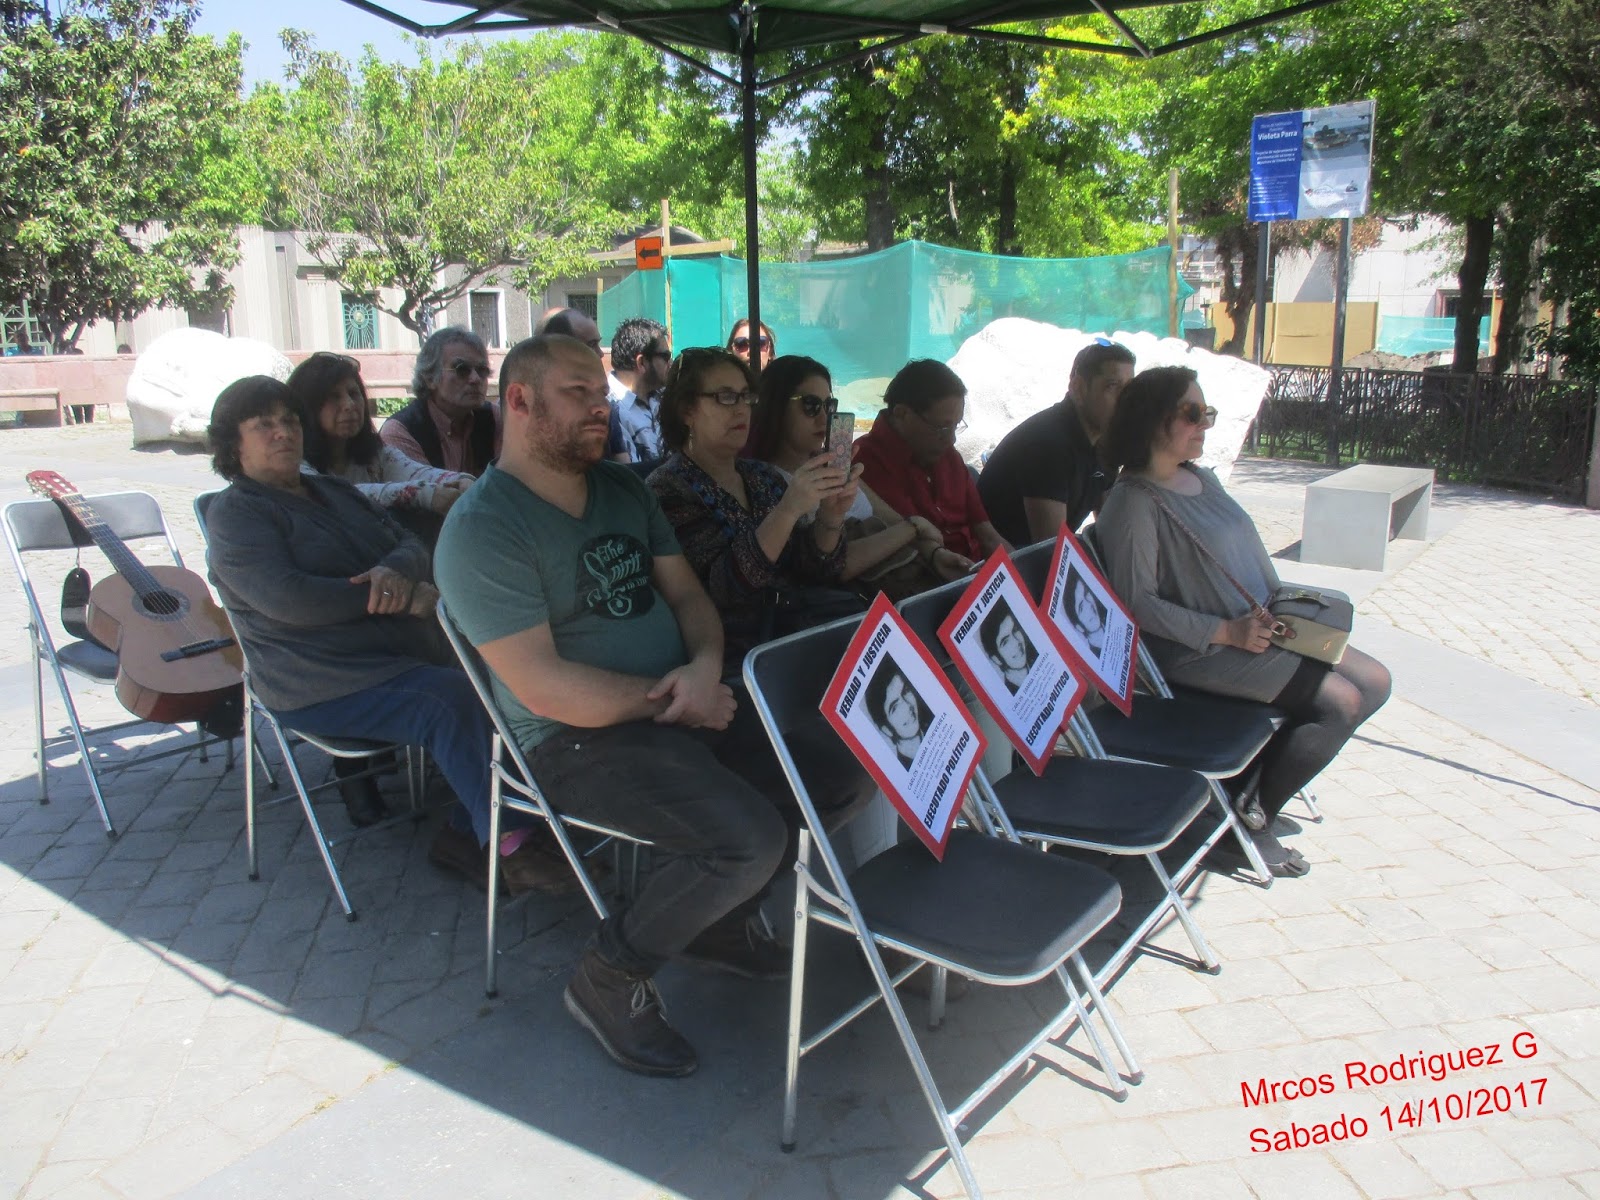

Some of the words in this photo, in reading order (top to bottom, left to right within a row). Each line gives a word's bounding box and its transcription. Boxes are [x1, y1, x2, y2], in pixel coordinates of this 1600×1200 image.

[1257, 133, 1280, 141] Violeta
[597, 539, 624, 562] The
[1049, 586, 1060, 619] VERDAD
[1058, 544, 1070, 579] JUSTICIA
[953, 610, 978, 645] VERDAD
[974, 602, 983, 614] Y
[981, 571, 1006, 608] JUSTICIA
[839, 676, 862, 719] VERDAD
[857, 665, 866, 678] Y
[863, 623, 892, 670] JUSTICIA
[1118, 658, 1130, 698] EJECUTADO
[1124, 623, 1133, 658] POLÍTICO
[1025, 702, 1055, 746] EJECUTADO
[1049, 670, 1070, 706] POLÍTICO
[908, 769, 919, 790] CARLOS
[923, 773, 950, 829] EJECUTADO
[945, 730, 970, 777] POLÍTICO
